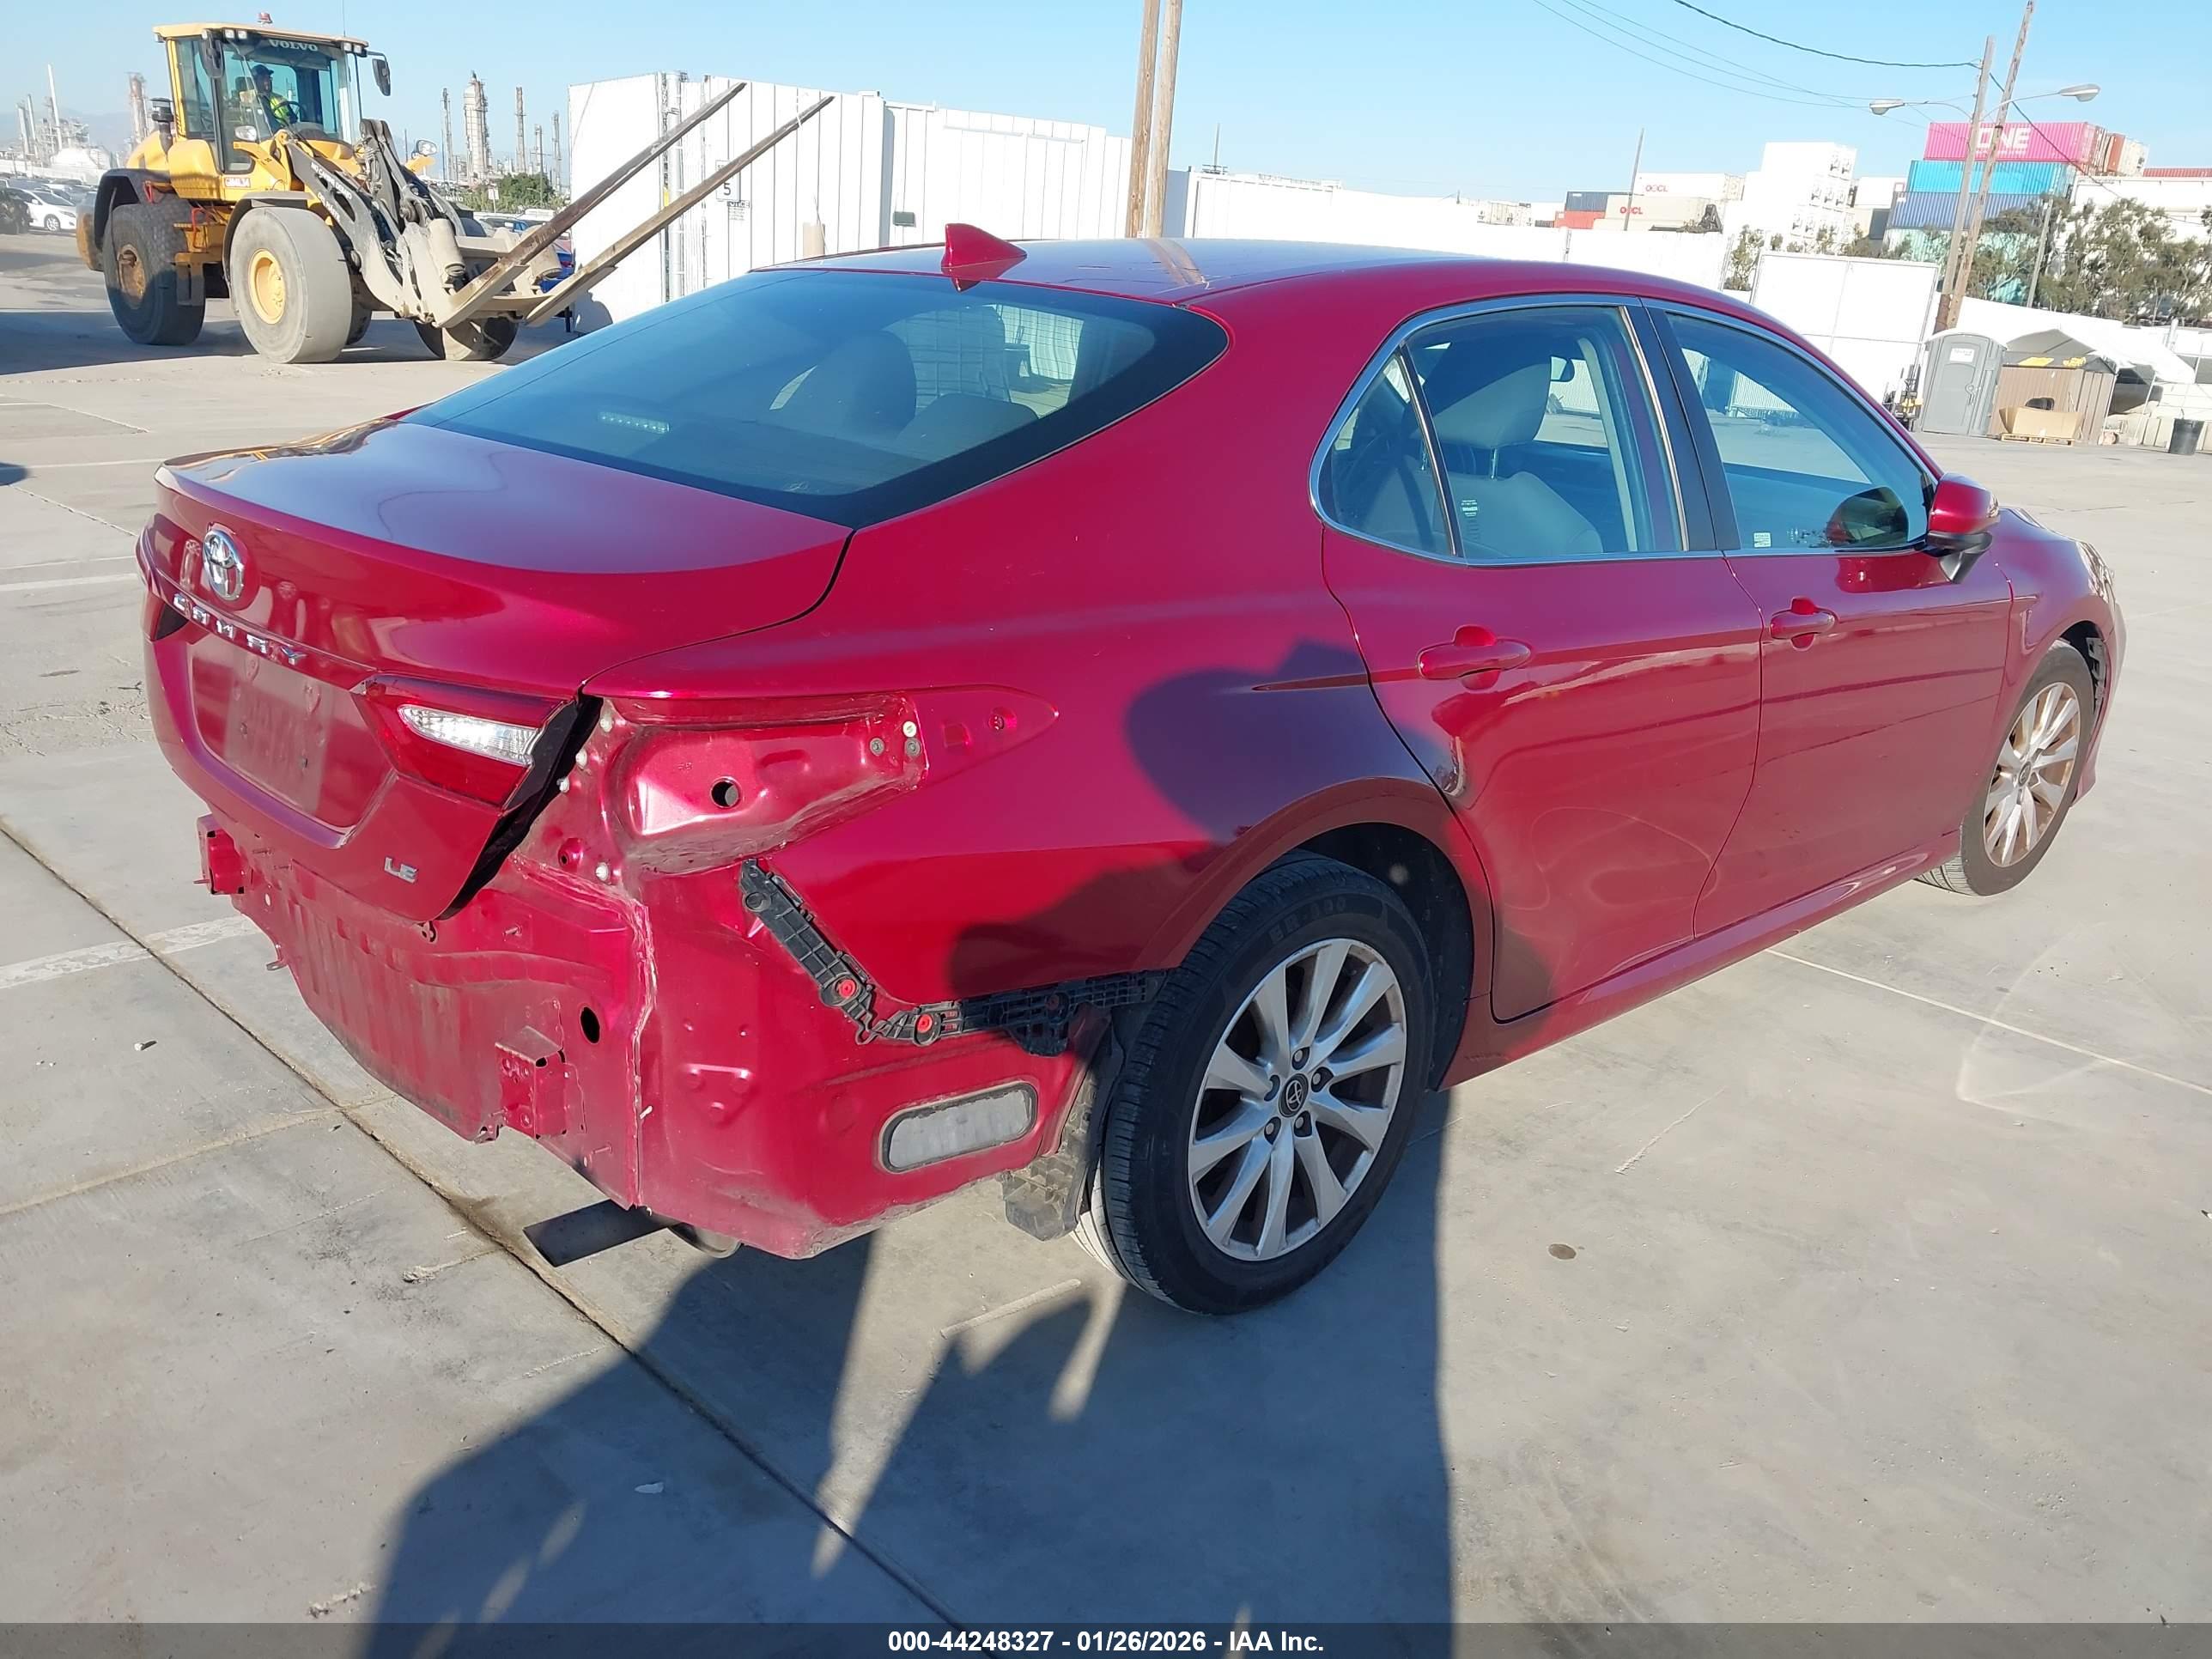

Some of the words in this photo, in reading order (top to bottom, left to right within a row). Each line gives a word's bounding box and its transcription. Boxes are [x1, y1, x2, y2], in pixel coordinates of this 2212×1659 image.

[268, 39, 319, 52] VOLVO
[1975, 127, 2031, 149] ONE
[723, 182, 732, 196] 5
[173, 592, 307, 665] CAMRY
[384, 856, 417, 884] LE
